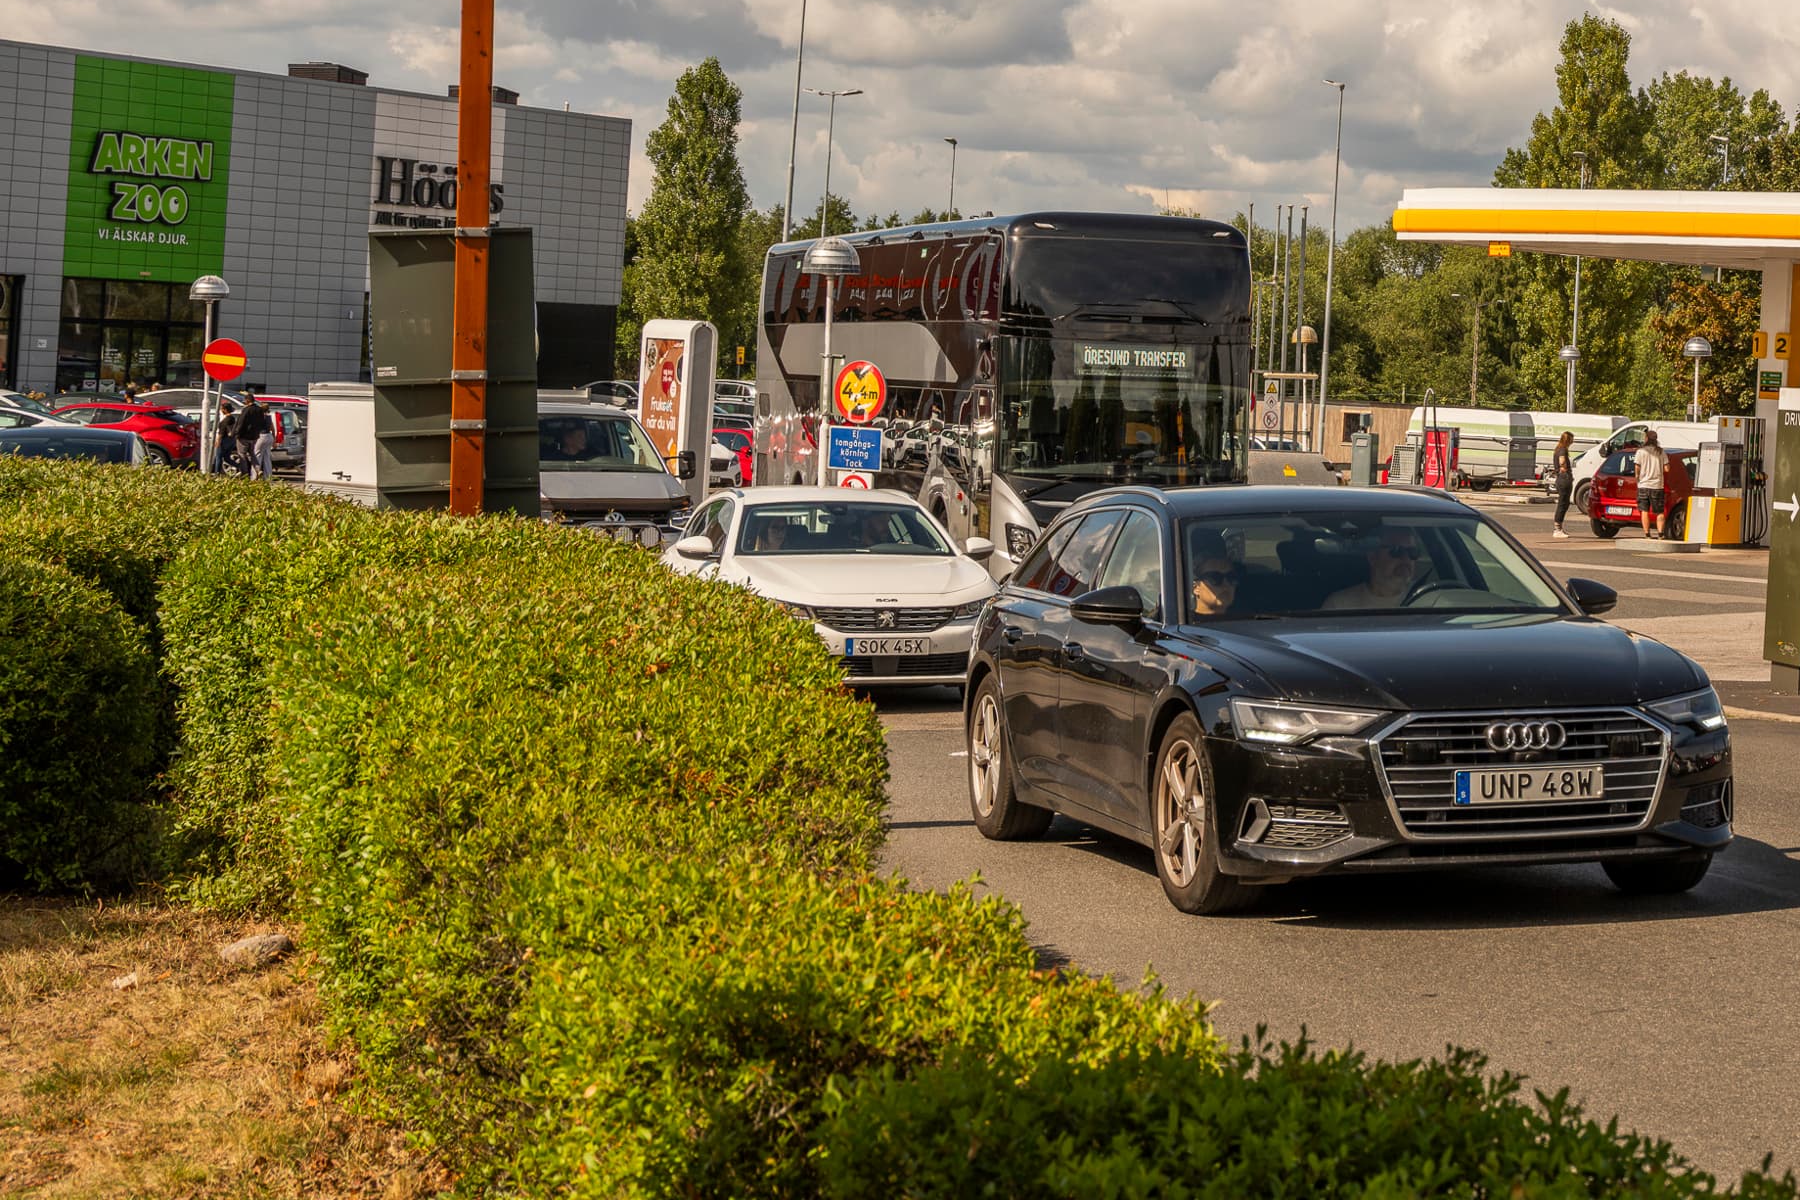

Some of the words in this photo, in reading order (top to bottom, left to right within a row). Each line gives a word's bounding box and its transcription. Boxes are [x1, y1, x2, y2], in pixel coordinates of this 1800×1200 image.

[92, 132, 213, 180] ARKEN
[374, 155, 505, 215] Höös
[111, 182, 189, 225] ZOO
[98, 227, 109, 240] VI
[112, 226, 155, 244] ÄLSKAR
[158, 232, 189, 246] DJUR.
[1754, 337, 1760, 353] 1
[1776, 338, 1787, 353] 2
[1084, 345, 1130, 366] ÖRESUND
[1133, 350, 1186, 368] TRANSFER
[657, 416, 665, 430] du
[666, 416, 676, 431] vill
[1735, 418, 1741, 427] 2
[852, 430, 860, 440] Ej
[835, 439, 876, 449] tomgångs-
[840, 449, 869, 460] körning
[844, 459, 863, 468] Tack
[859, 640, 888, 654] SOK
[893, 639, 923, 654] 45X
[1480, 773, 1532, 799] UNP
[1541, 770, 1593, 798] 48W
